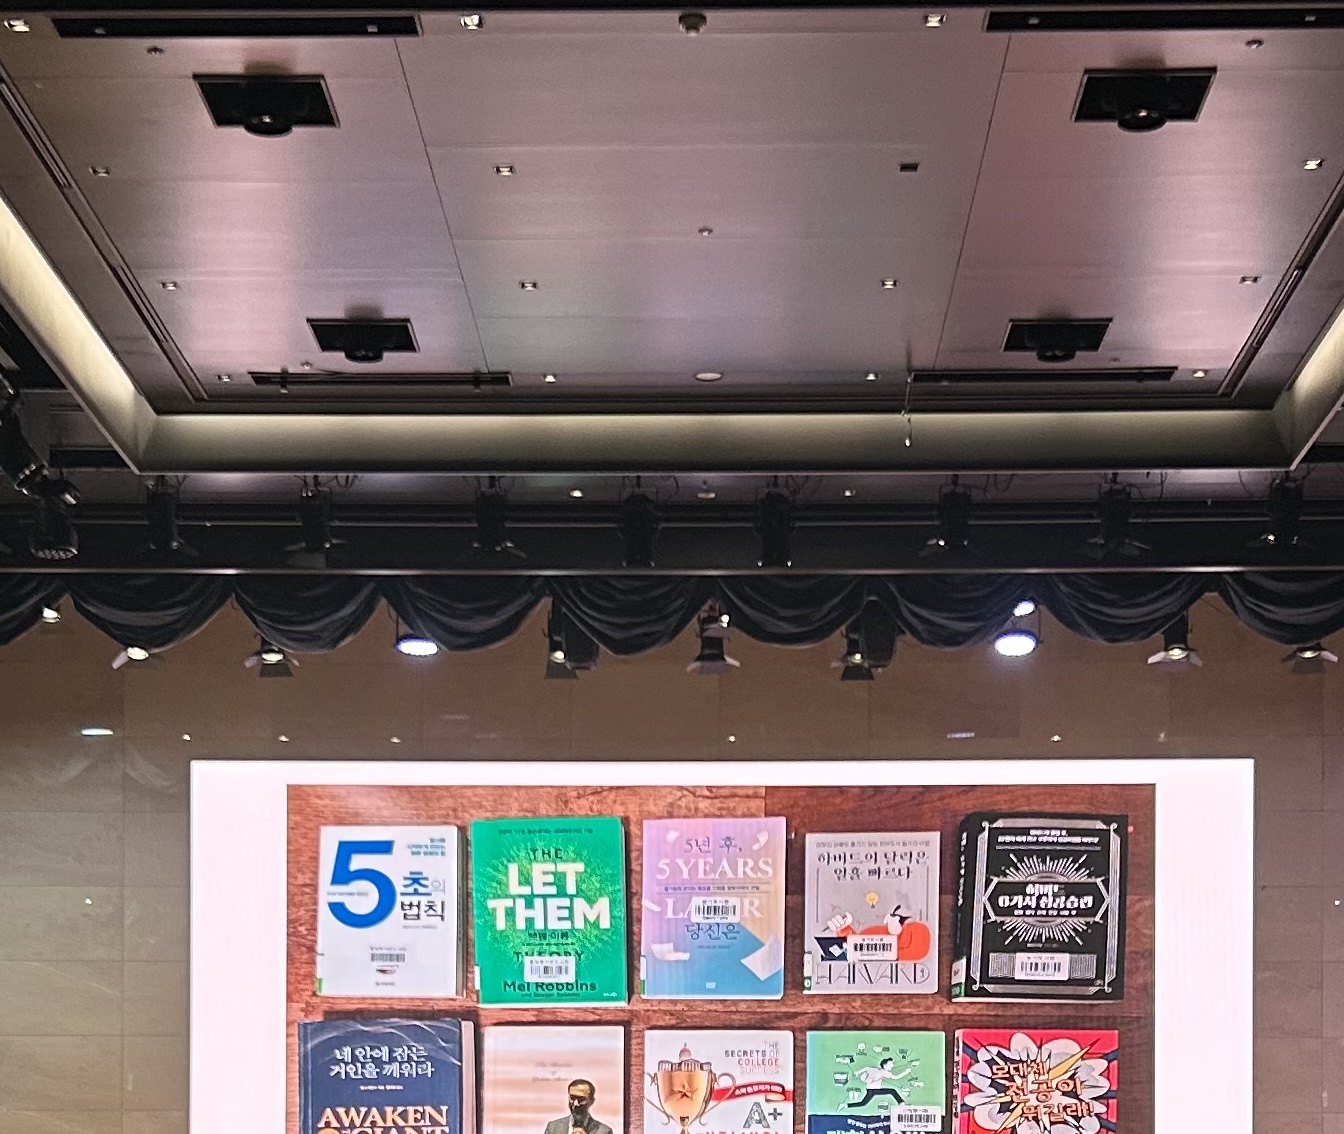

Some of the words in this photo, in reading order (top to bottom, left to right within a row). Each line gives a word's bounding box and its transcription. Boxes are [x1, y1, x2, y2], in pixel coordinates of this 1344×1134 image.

[530, 848, 563, 860] THE
[684, 836, 712, 853] 5년
[507, 862, 585, 895] LET
[656, 858, 670, 880] 5
[675, 857, 774, 880] YEARS
[327, 840, 397, 929] 5
[400, 900, 445, 922] 법칙
[487, 897, 611, 931] THEM
[685, 923, 741, 940] 당신은
[503, 980, 530, 992] Mel
[535, 980, 597, 992] Robbins
[335, 1047, 351, 1062] 네
[355, 1046, 389, 1062] 안에
[329, 1063, 380, 1079] 거인을
[317, 1105, 449, 1128] AWAKEN
[743, 1102, 783, 1128] A+
